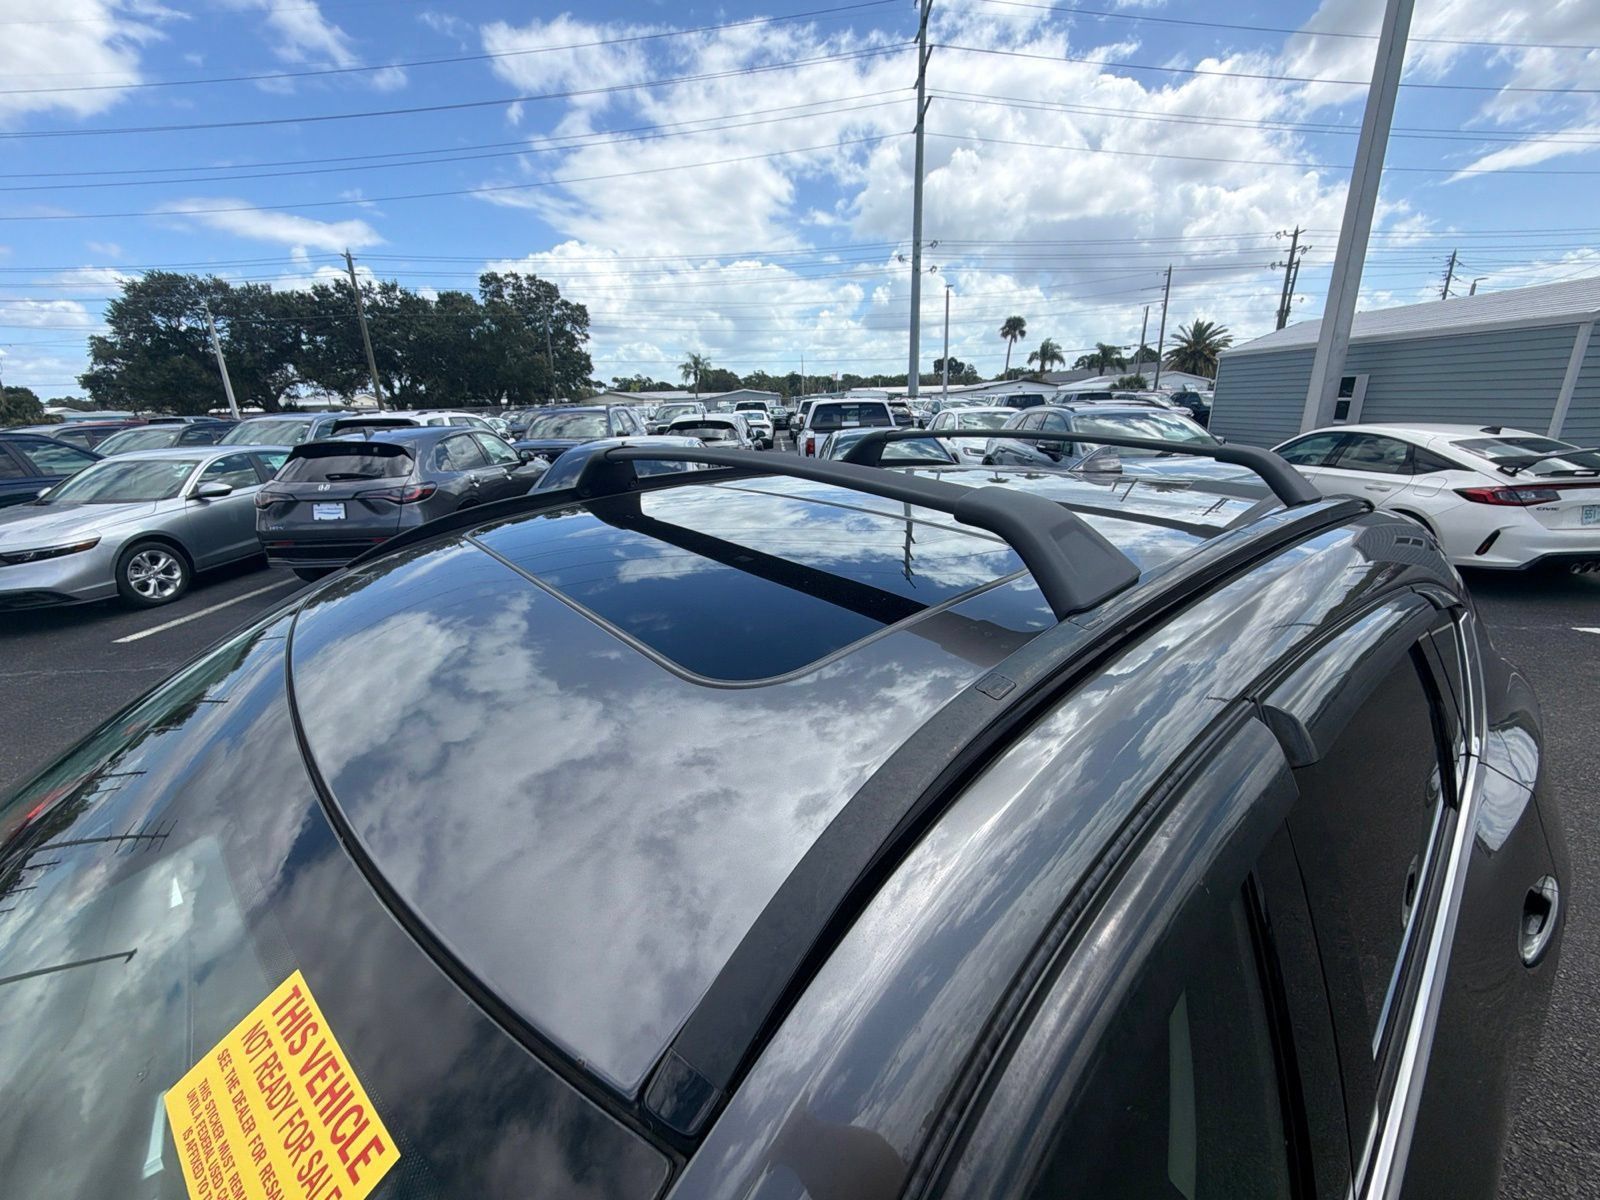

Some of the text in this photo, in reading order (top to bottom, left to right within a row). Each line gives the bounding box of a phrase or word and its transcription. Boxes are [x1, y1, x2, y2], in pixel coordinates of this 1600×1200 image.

[240, 1019, 273, 1063] NOT
[187, 1087, 201, 1116] UNTIL
[253, 1051, 298, 1120] READY
[272, 984, 386, 1186] THIS VEHICLE
[182, 1126, 193, 1141] IS
[193, 1111, 203, 1123] A
[198, 1077, 212, 1102] THIS
[205, 1098, 225, 1143] STICKER
[218, 1139, 236, 1174] MUST
[217, 1048, 285, 1200] SEE THE DEALER FOR RESA
[278, 1107, 315, 1168] FOR
[186, 1138, 205, 1180] AFFIXED
[196, 1119, 215, 1164] FEDERAL
[197, 1175, 209, 1195] TO
[208, 1158, 224, 1190] USED
